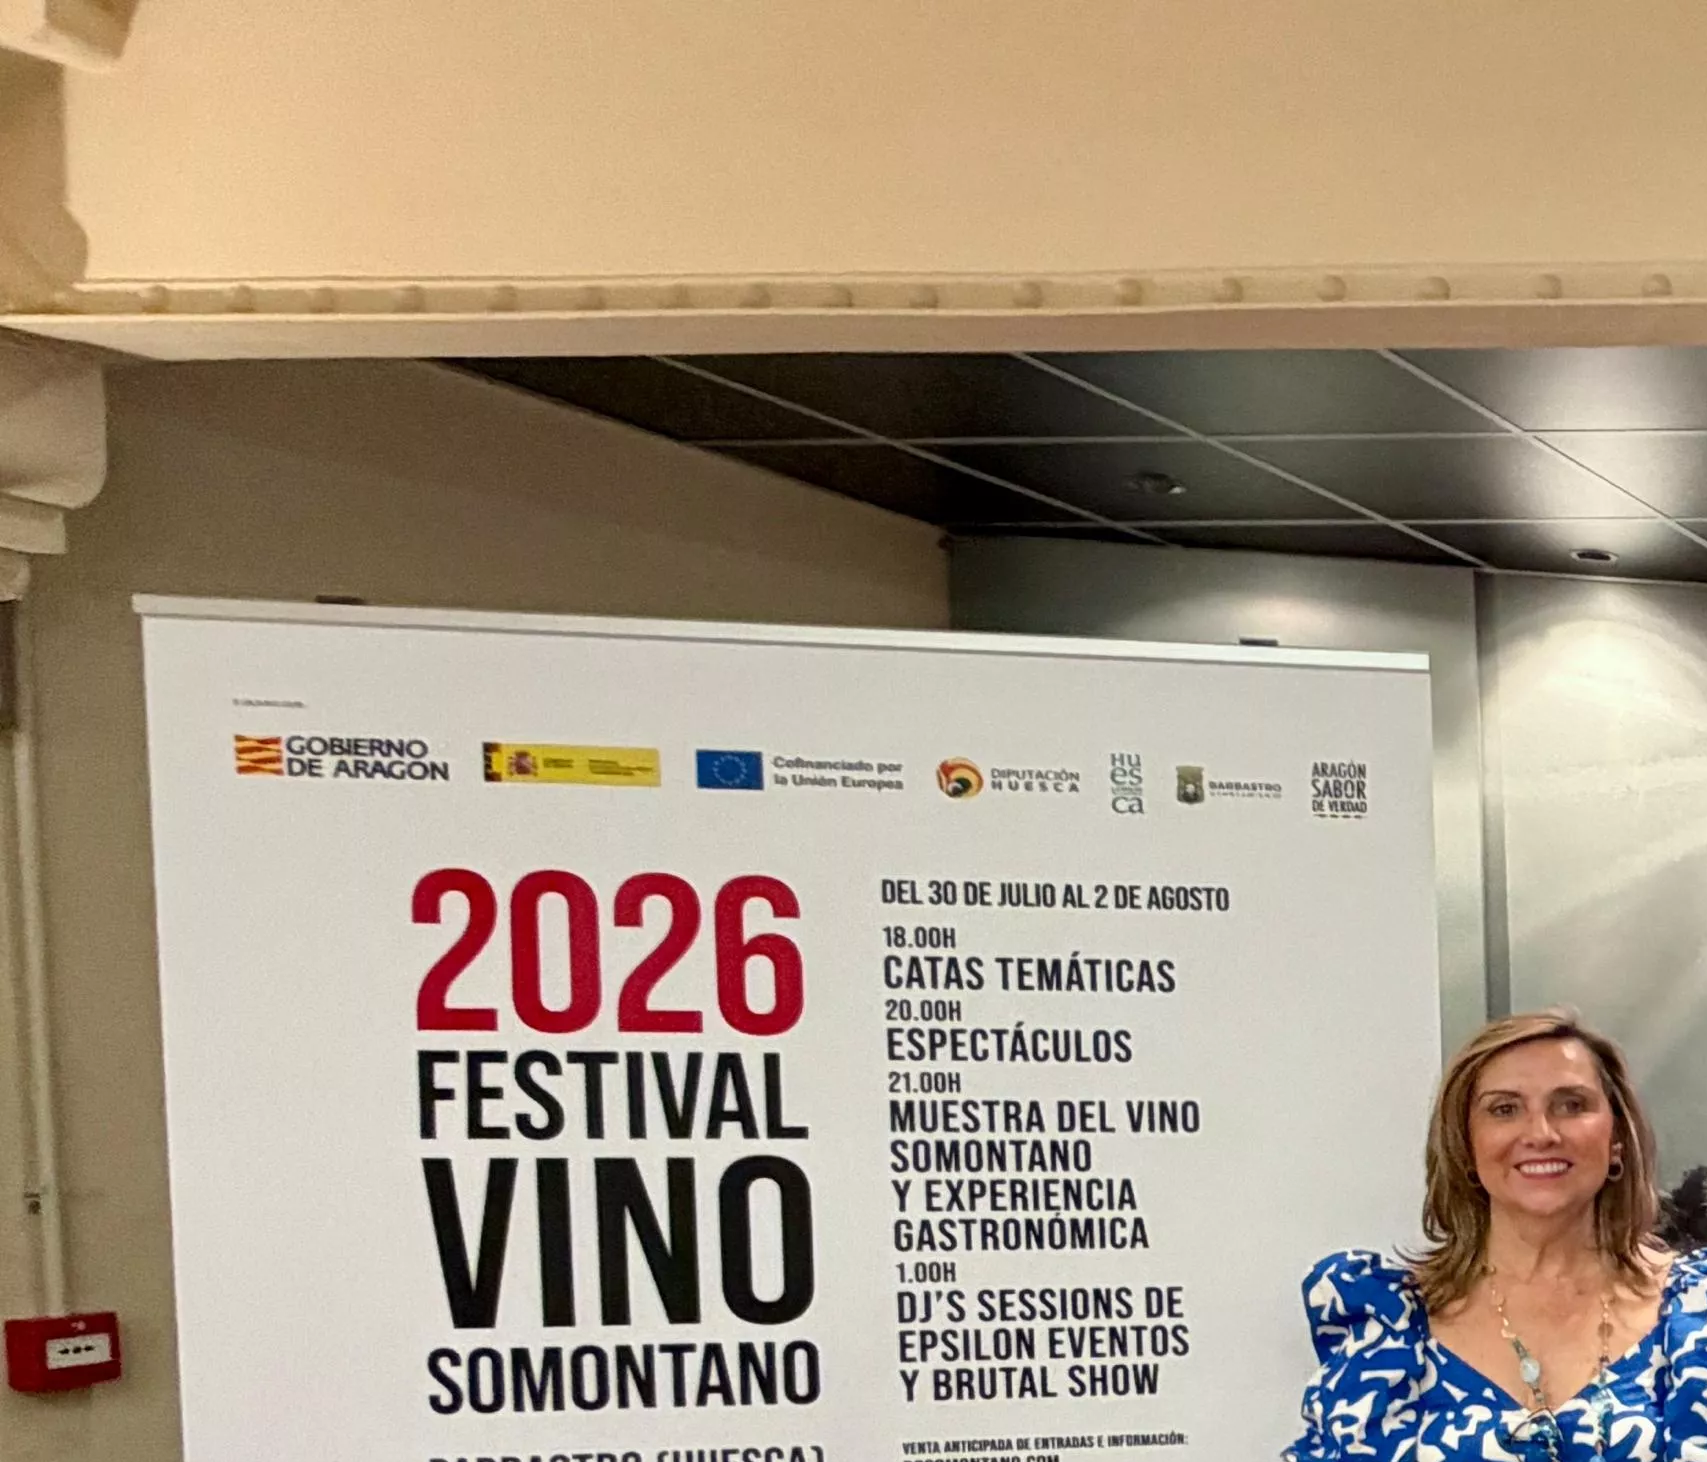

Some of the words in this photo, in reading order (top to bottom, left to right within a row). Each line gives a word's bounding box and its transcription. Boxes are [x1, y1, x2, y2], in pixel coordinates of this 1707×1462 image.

[286, 735, 428, 759] GOBIERNO
[286, 759, 324, 777] DE
[333, 760, 449, 781] ARAGON
[773, 756, 873, 772] Cofinanciado
[877, 762, 903, 774] por
[991, 768, 1080, 781] DIPUTACIÓN
[1312, 760, 1366, 779] ARAGÓN
[774, 774, 788, 786] la
[841, 776, 904, 792] Europea
[991, 781, 1079, 792] HUESCA
[1209, 781, 1282, 792] BARBASTRO
[1312, 779, 1366, 799] SABOR
[1312, 801, 1325, 812] DE
[1328, 801, 1367, 813] VERDAD
[881, 879, 923, 905] DEL
[928, 880, 958, 906] 30
[964, 882, 992, 907] DE
[997, 882, 1056, 908] JULIO
[1062, 884, 1090, 909] AL
[1094, 884, 1109, 909] 2
[1115, 885, 1142, 910] DE
[1147, 885, 1230, 912] AGOSTO
[882, 925, 956, 948] 18.00H
[411, 867, 805, 1038] 2026
[883, 955, 985, 990] CATAS
[995, 951, 1176, 993] TEMÁTICAS
[885, 999, 961, 1022] 20.00H
[886, 1021, 1133, 1063] ESPECTÁCULOS
[416, 1048, 809, 1141] FESTIVAL
[887, 1071, 961, 1094] 21.00H
[889, 1100, 1046, 1133] MUESTRA
[1056, 1101, 1116, 1132] DEL
[1126, 1101, 1201, 1132] VINO
[890, 1139, 1092, 1173] SOMONTANO
[892, 1179, 913, 1213] Y
[925, 1178, 1138, 1212] EXPERIENCIA
[420, 1153, 815, 1329] VINO
[893, 1212, 1150, 1252] GASTRONÓMICA
[895, 1261, 957, 1284] 1.00H
[897, 1290, 966, 1324] DJ'S
[977, 1287, 1133, 1322] SESSIONS
[1145, 1286, 1184, 1319] DE
[899, 1328, 1036, 1363] EPSILON
[1048, 1324, 1190, 1359] EVENTOS
[427, 1339, 821, 1415] SOMONTANO
[899, 1370, 920, 1402] Y
[933, 1366, 1058, 1402] BRUTAL
[1069, 1363, 1159, 1398] SHOW
[903, 1440, 941, 1455] VENTA
[943, 1437, 1014, 1453] ANTICIPADA
[1016, 1437, 1031, 1450] DE
[1034, 1435, 1094, 1450] ENTRADAS
[1107, 1430, 1189, 1448] INFORMACIÓN:
